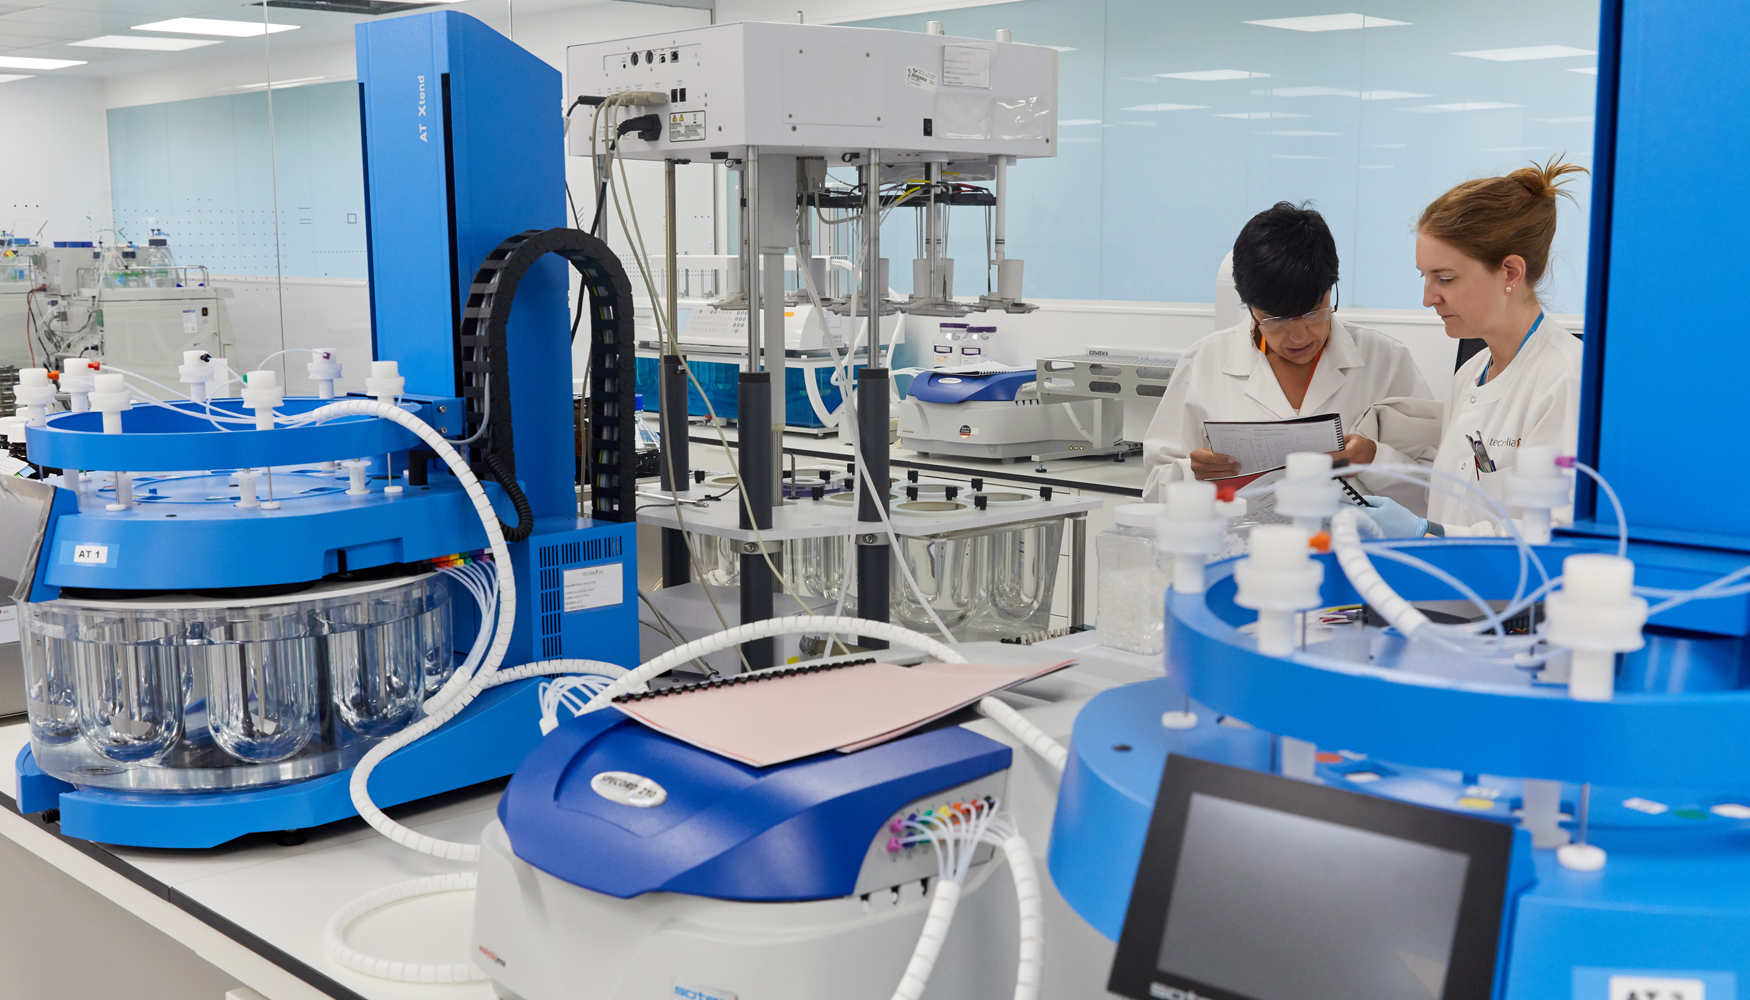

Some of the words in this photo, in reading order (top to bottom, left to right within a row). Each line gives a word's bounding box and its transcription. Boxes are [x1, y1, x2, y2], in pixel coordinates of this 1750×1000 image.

[417, 75, 427, 117] Xtend
[418, 123, 428, 143] AT
[78, 550, 92, 558] AT
[95, 550, 100, 559] 1
